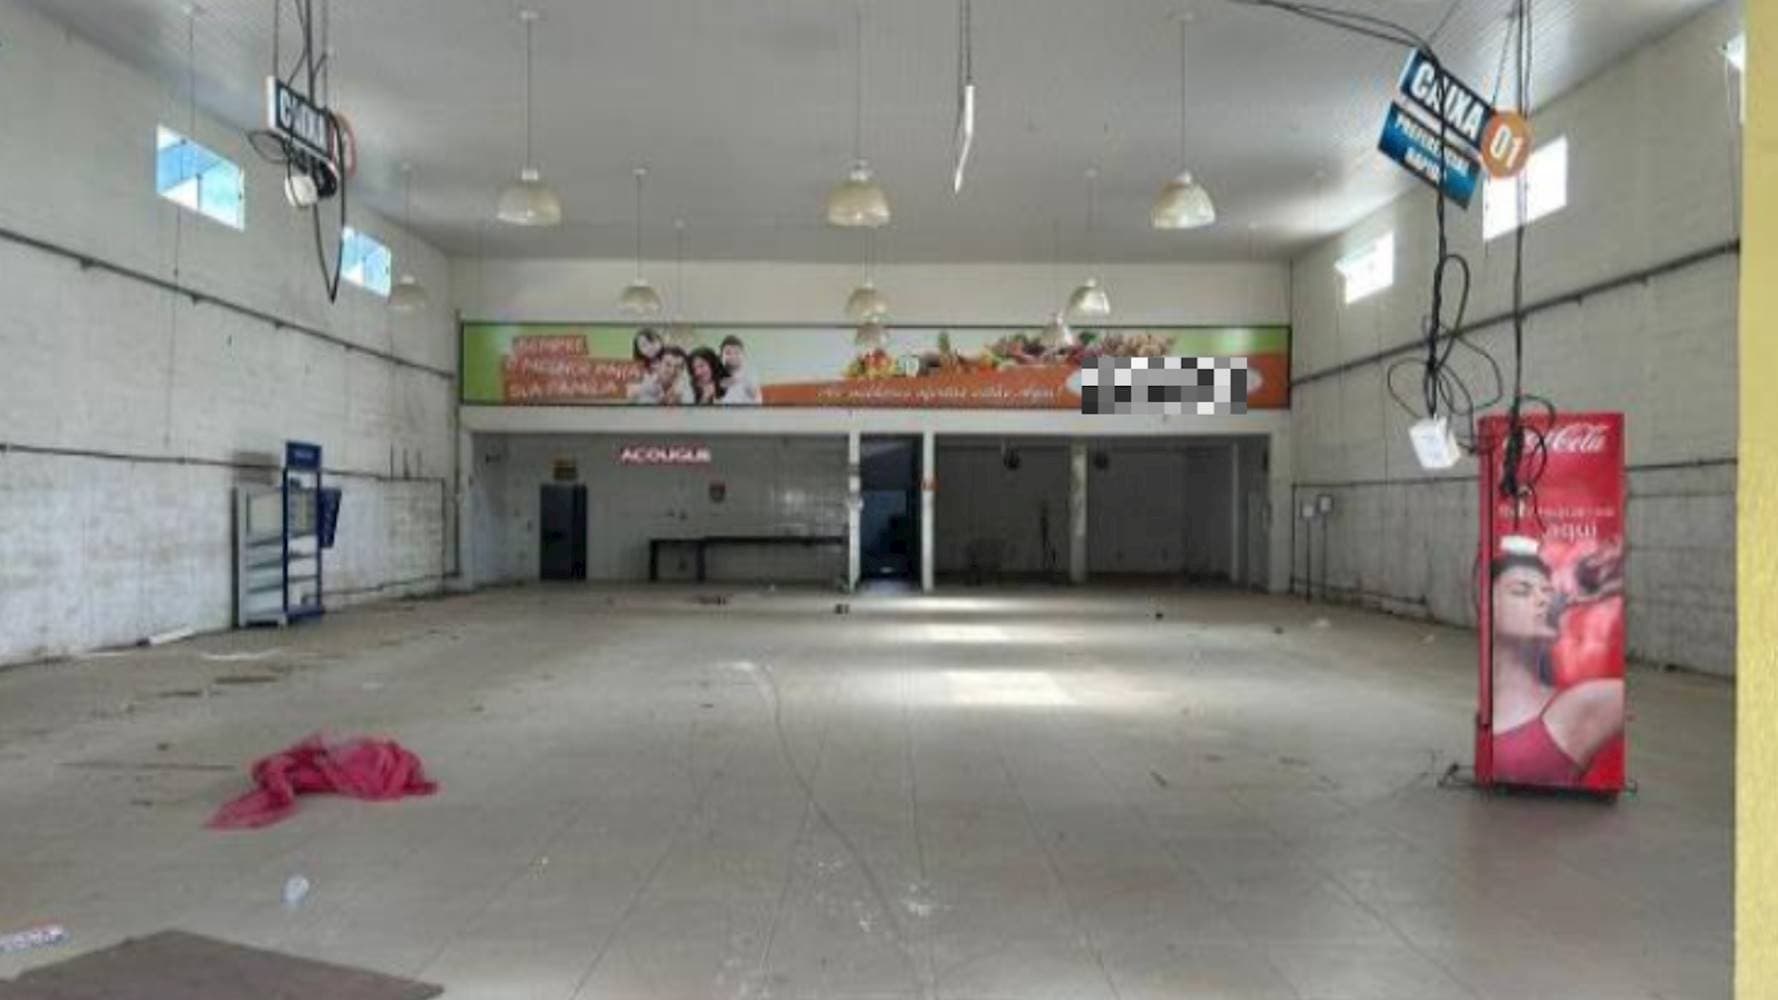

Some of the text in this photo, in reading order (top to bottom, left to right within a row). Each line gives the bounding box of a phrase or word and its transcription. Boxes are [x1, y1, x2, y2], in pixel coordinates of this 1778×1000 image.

[1410, 62, 1486, 141] CAIXA
[1489, 123, 1525, 170] 01
[1503, 422, 1609, 454] oca-Cola
